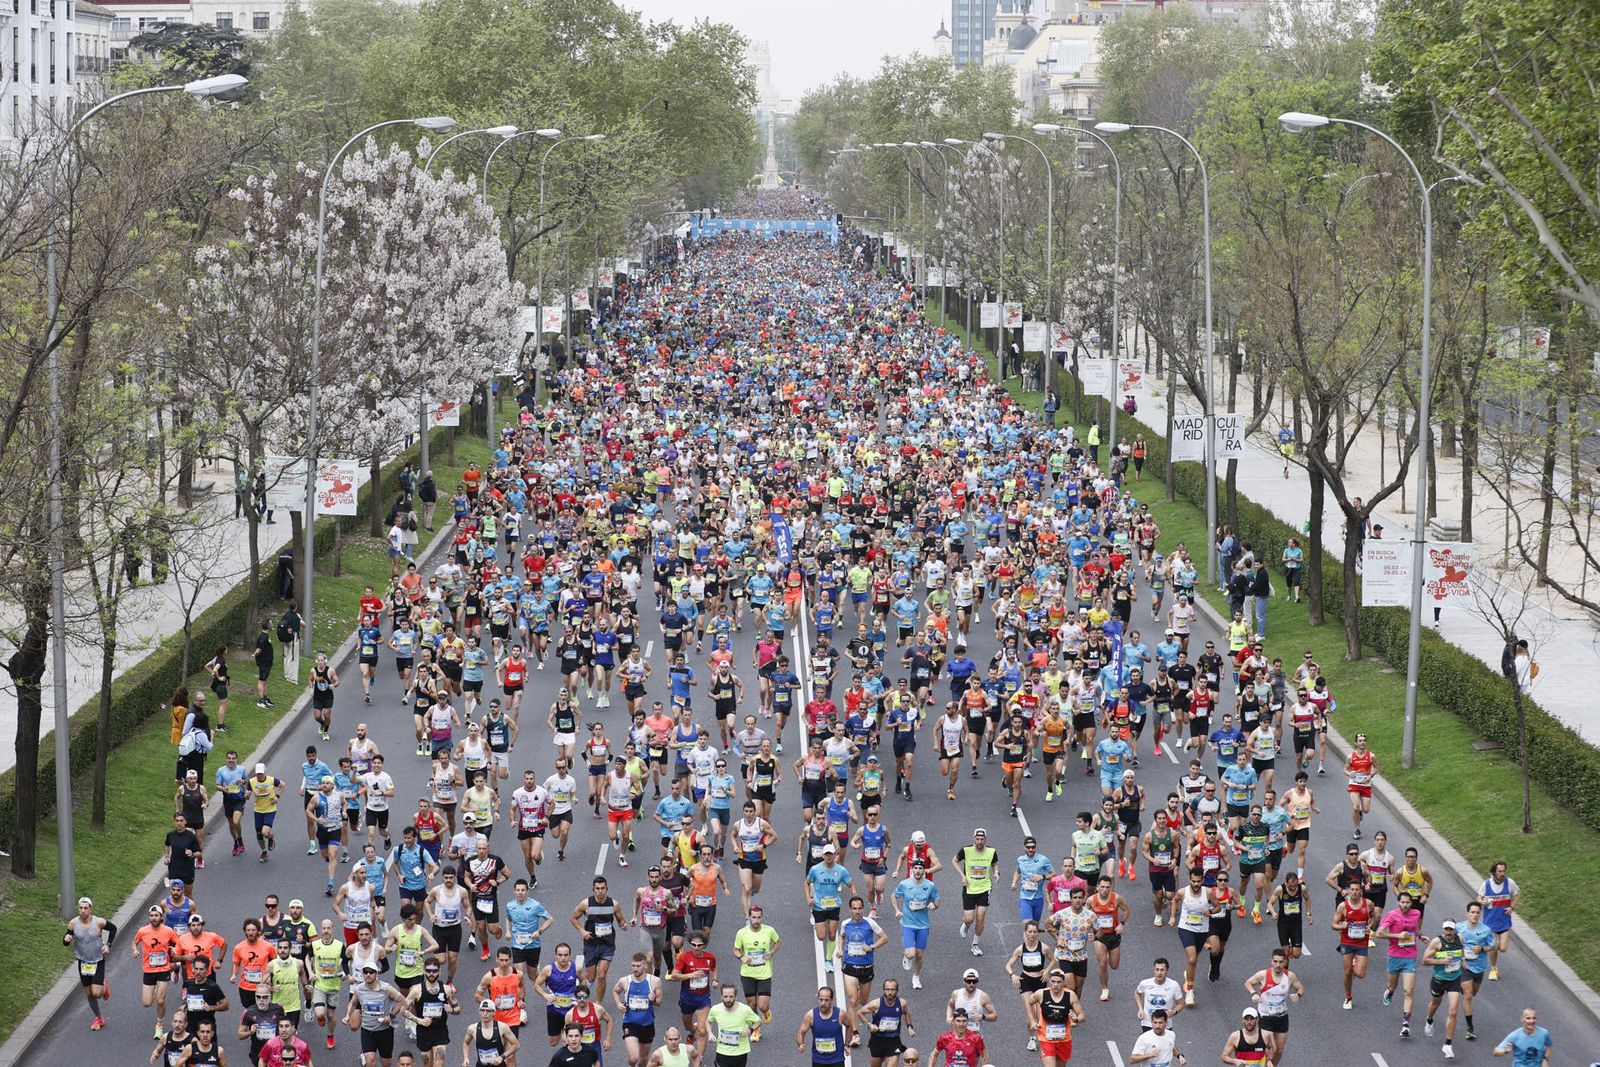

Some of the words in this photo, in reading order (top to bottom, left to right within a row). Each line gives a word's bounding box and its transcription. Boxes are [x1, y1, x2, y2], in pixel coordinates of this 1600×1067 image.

[1173, 418, 1204, 430] MAD
[1183, 430, 1203, 440] RID
[1220, 428, 1235, 440] TU
[1225, 440, 1242, 450] RA
